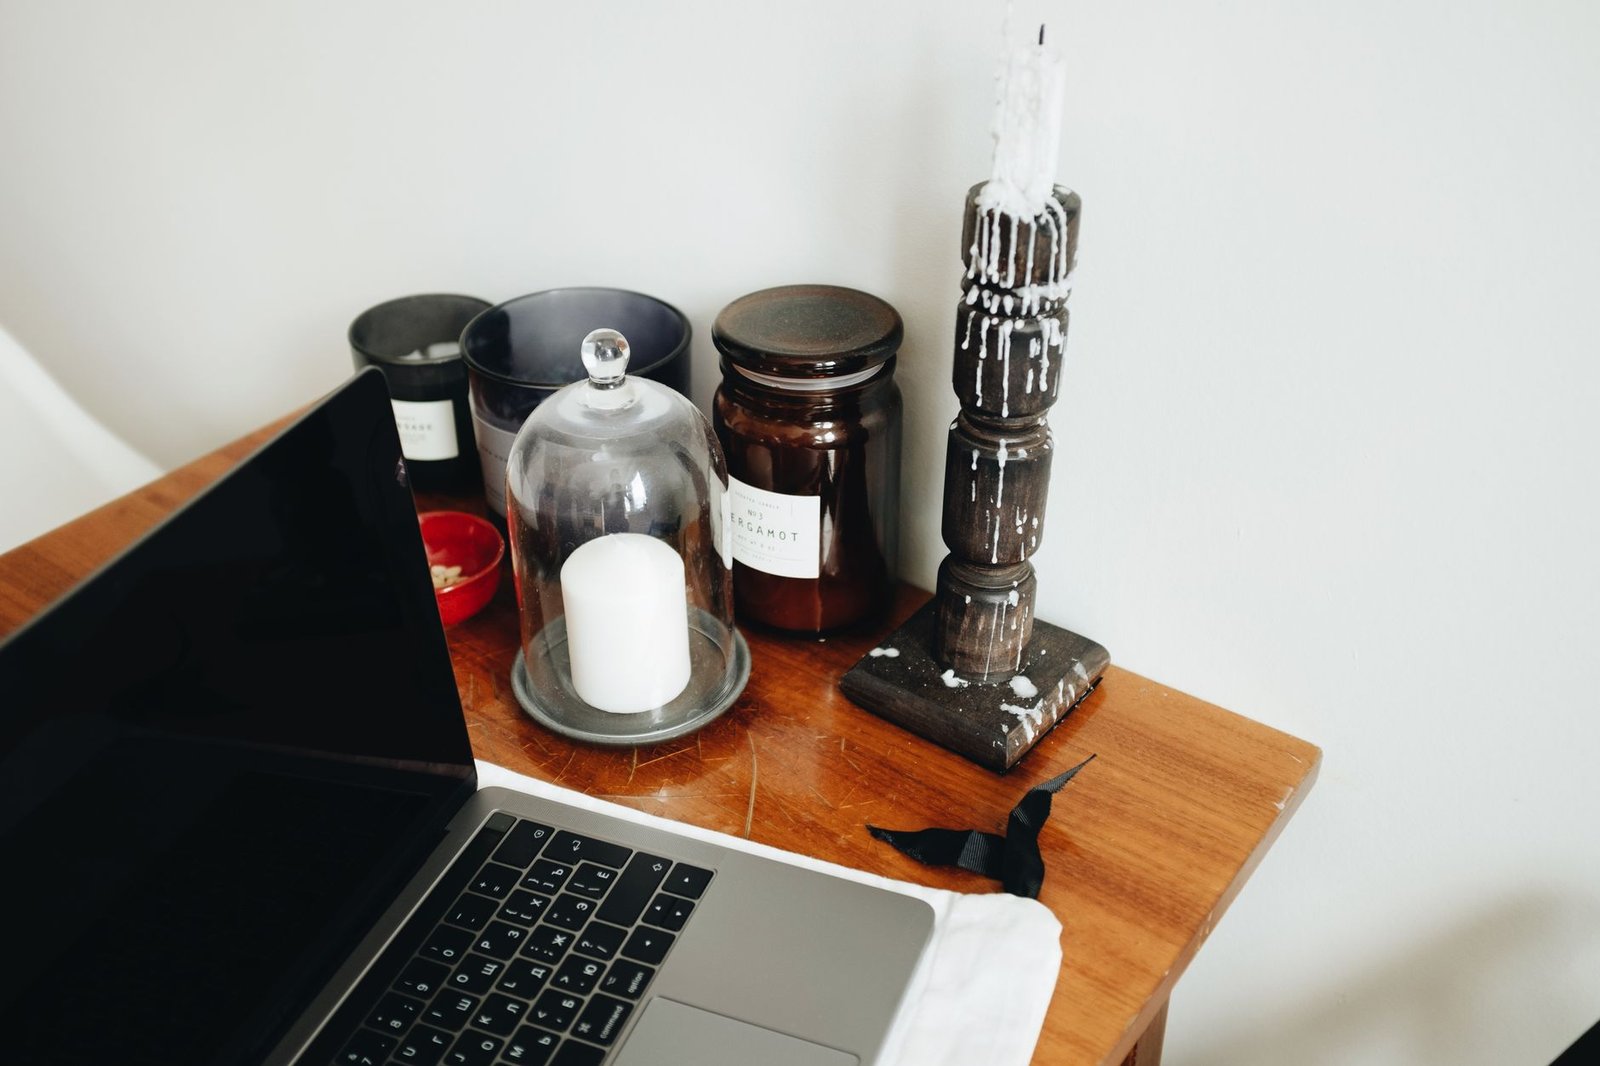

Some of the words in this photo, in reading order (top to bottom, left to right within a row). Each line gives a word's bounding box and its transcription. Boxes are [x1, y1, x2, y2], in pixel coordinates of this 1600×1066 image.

[731, 512, 798, 542] ERGAMOT
[627, 971, 645, 994] option
[600, 1005, 625, 1039] command
